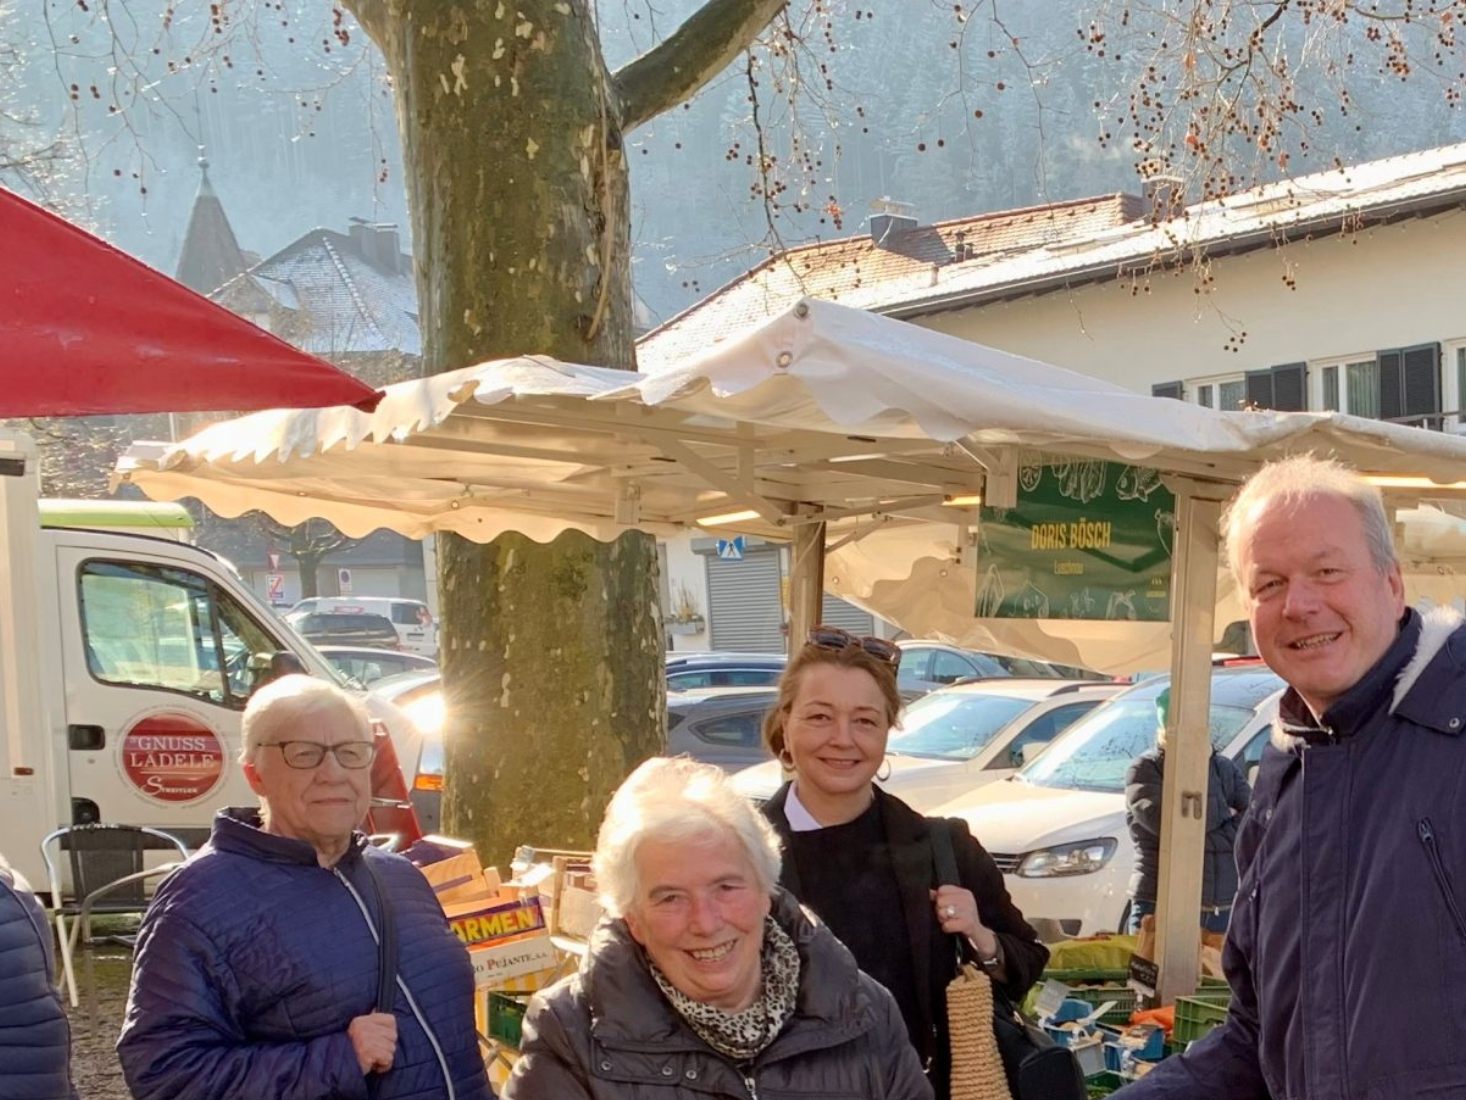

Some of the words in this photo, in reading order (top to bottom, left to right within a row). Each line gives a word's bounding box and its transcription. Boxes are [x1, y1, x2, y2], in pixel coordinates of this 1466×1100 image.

[1031, 523, 1067, 550] DORIS
[1069, 517, 1112, 549] BÖSCH
[449, 907, 534, 943] ARMEN
